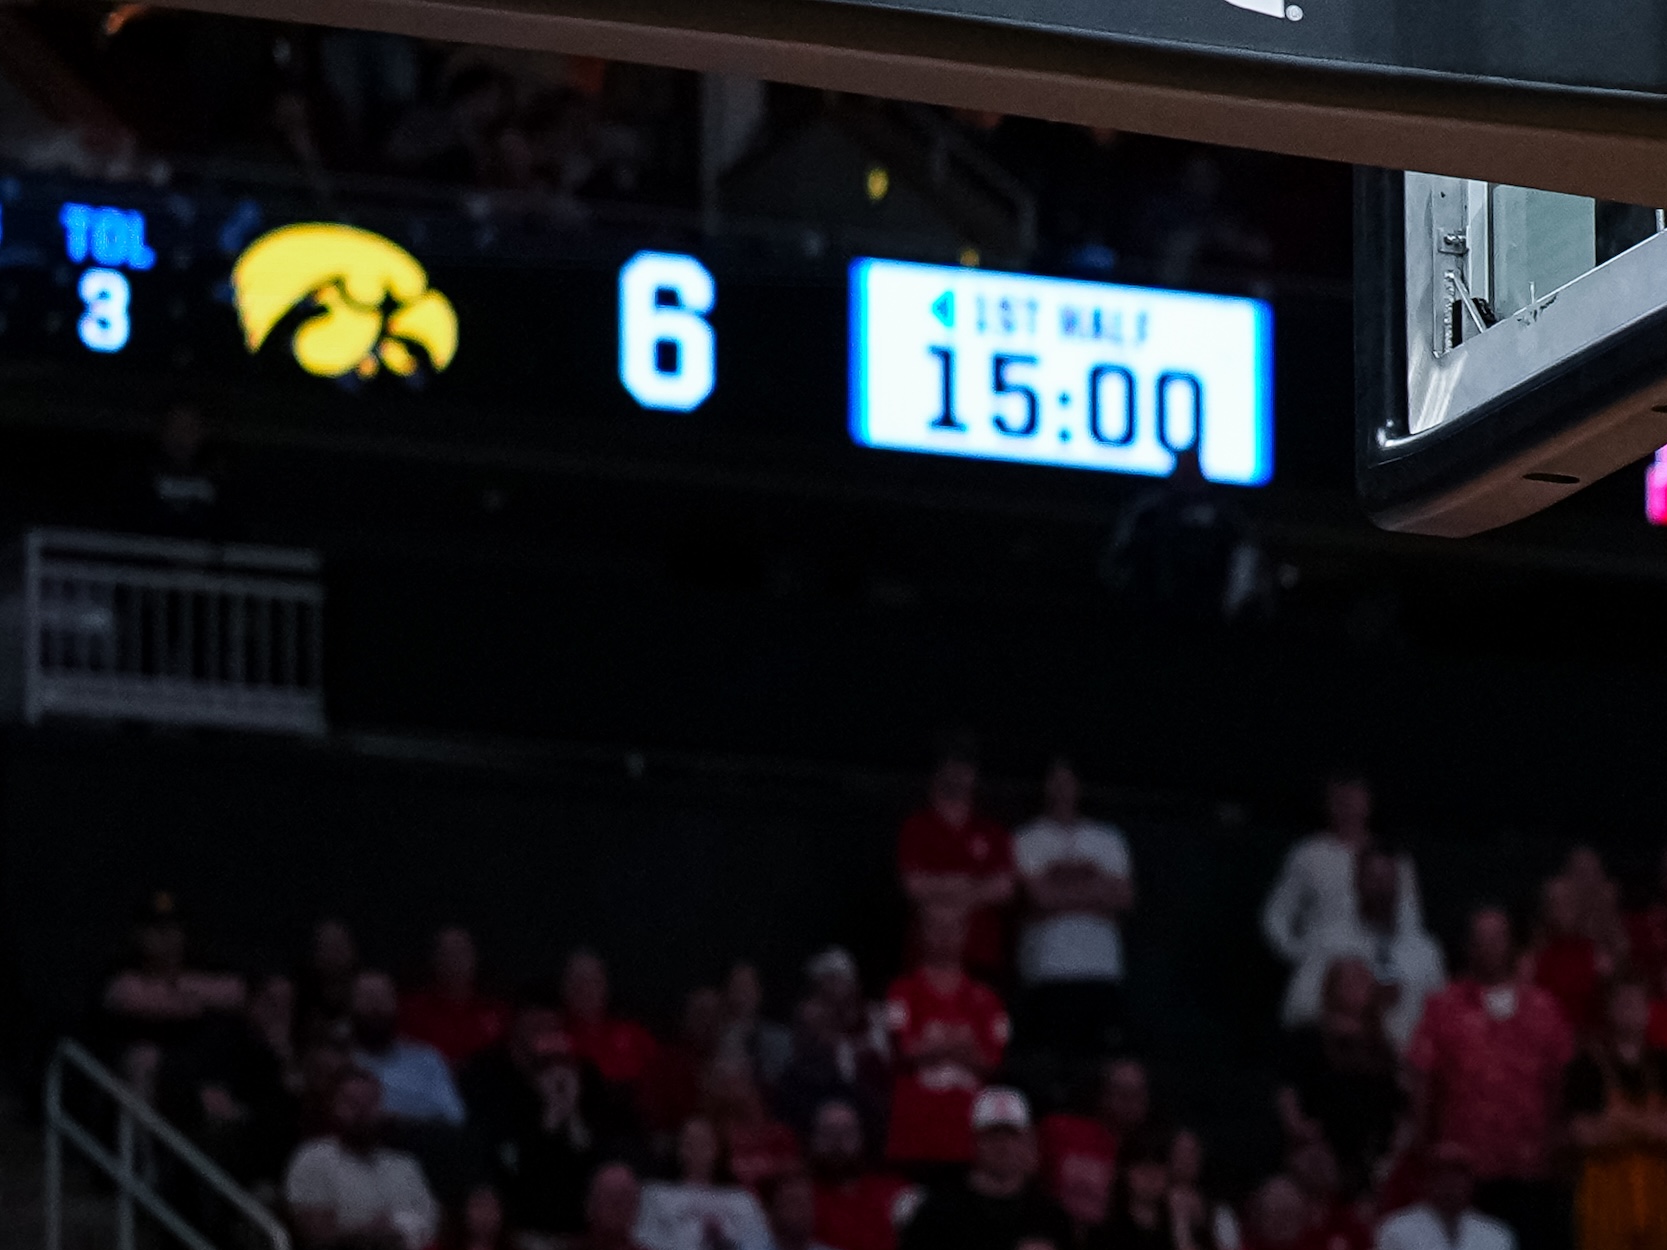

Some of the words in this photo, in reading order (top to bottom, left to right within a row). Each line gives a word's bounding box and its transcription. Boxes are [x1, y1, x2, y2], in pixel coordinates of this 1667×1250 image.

[60, 203, 155, 270] TOL
[78, 268, 131, 352] 3
[618, 250, 717, 413] 6
[976, 293, 1038, 335] 1ST
[1060, 304, 1151, 346] HALF
[927, 346, 1203, 454] 15:00
